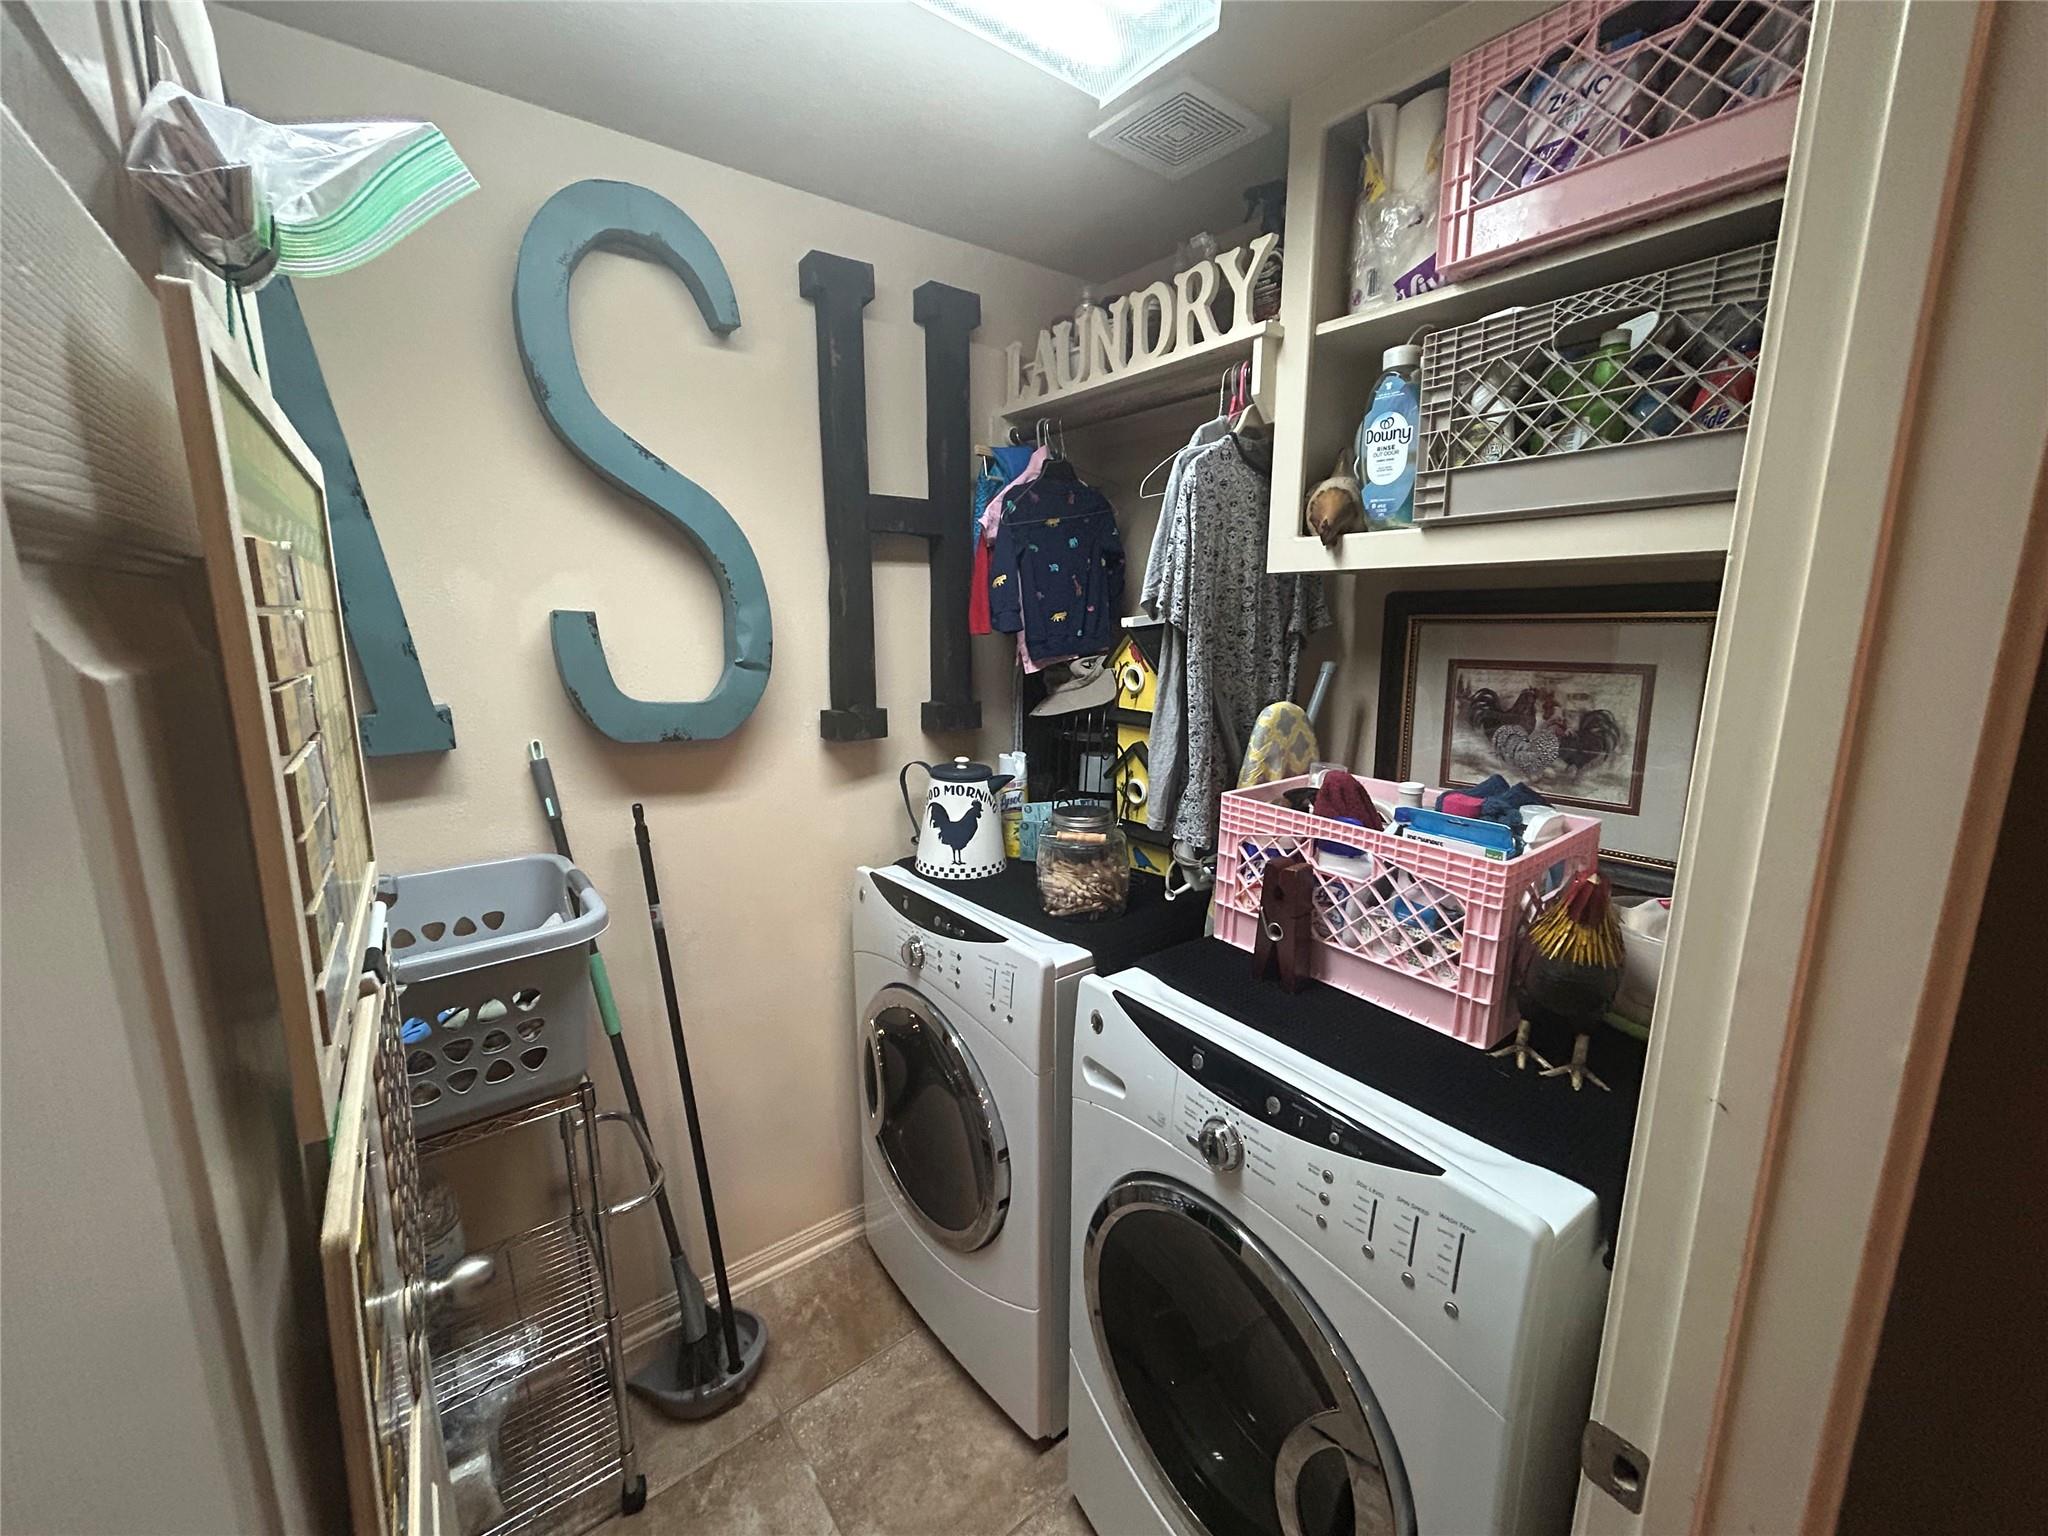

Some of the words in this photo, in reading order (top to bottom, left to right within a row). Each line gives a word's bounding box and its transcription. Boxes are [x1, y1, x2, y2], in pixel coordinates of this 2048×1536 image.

[1004, 234, 1279, 408] LAUNDRY
[1366, 426, 1412, 445] Downy
[1377, 444, 1396, 452] RINSE
[944, 785, 998, 814] MORNING
[1439, 1212, 1458, 1225] WASH
